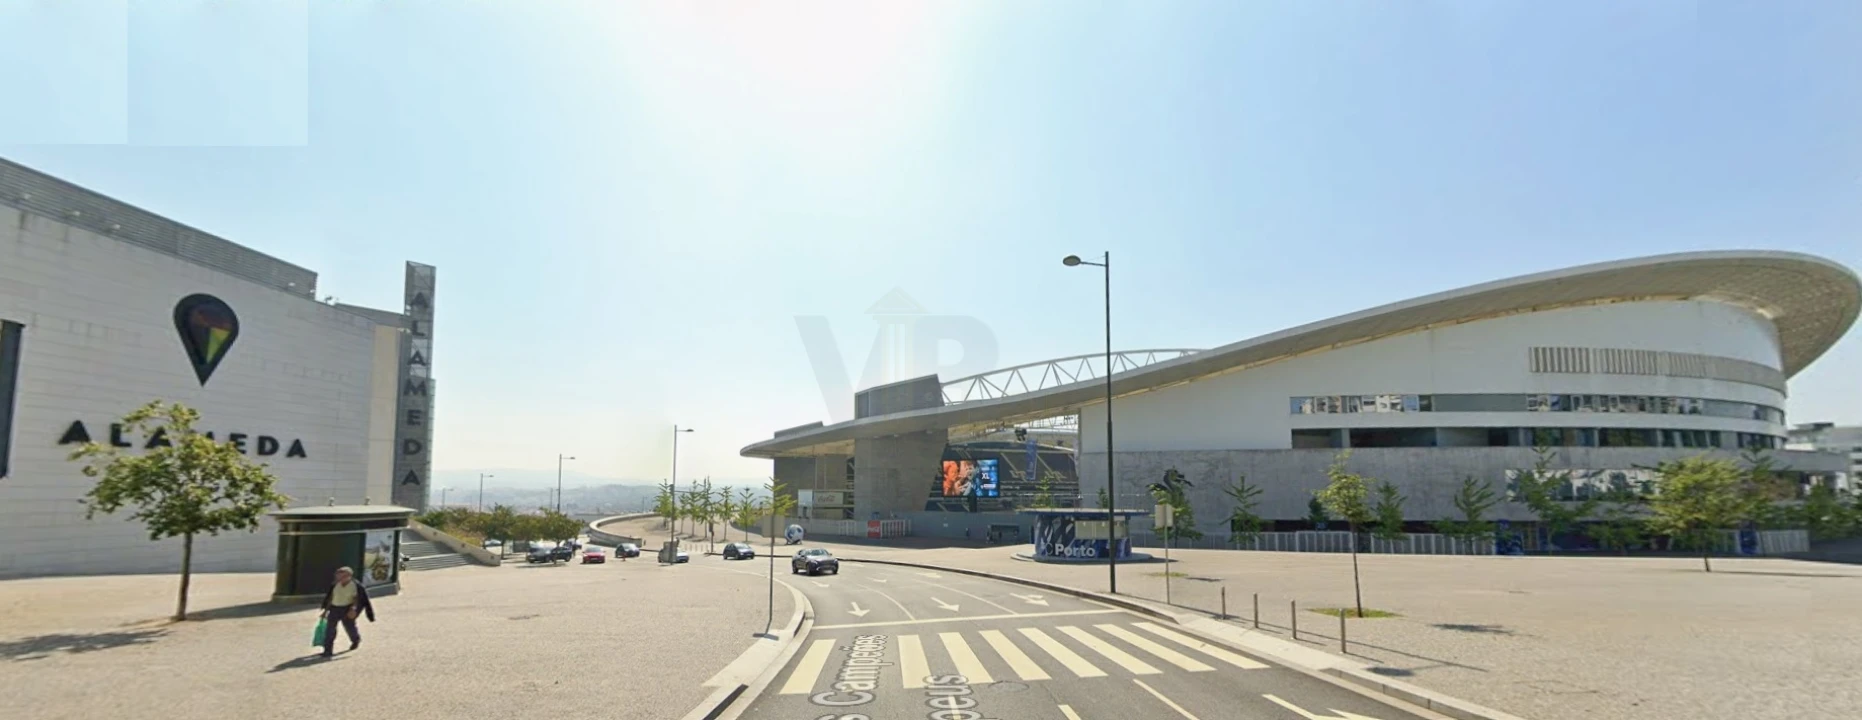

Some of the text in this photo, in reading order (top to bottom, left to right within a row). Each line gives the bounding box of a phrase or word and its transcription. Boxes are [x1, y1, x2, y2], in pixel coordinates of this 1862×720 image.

[402, 291, 429, 487] ALAMEDA
[58, 420, 307, 458] ALAEDA
[1055, 543, 1096, 557] Porto
